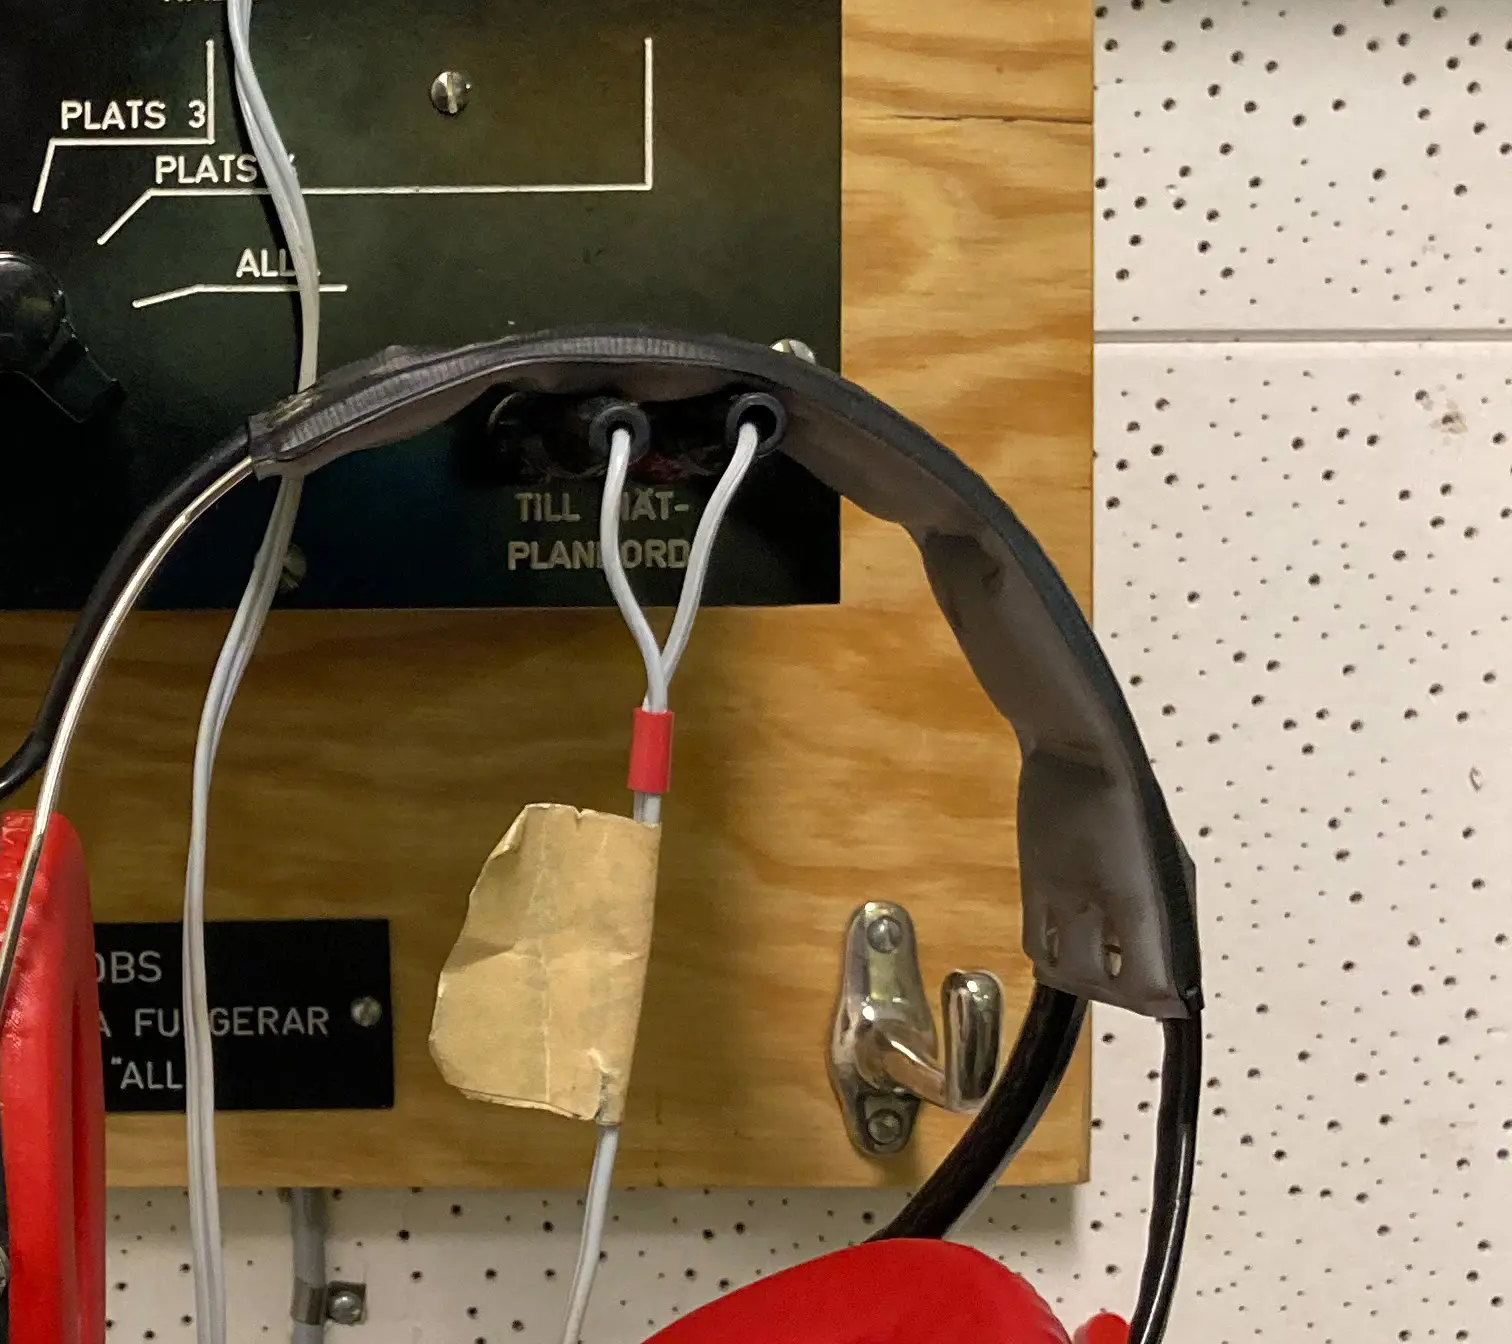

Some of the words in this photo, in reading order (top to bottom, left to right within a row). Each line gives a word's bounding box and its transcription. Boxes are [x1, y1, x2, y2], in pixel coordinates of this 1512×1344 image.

[61, 99, 167, 131] PLATS
[188, 99, 207, 129] 3
[154, 153, 258, 185] PLATS
[513, 492, 581, 522] TILL
[134, 1006, 330, 1038] FUGERAR
